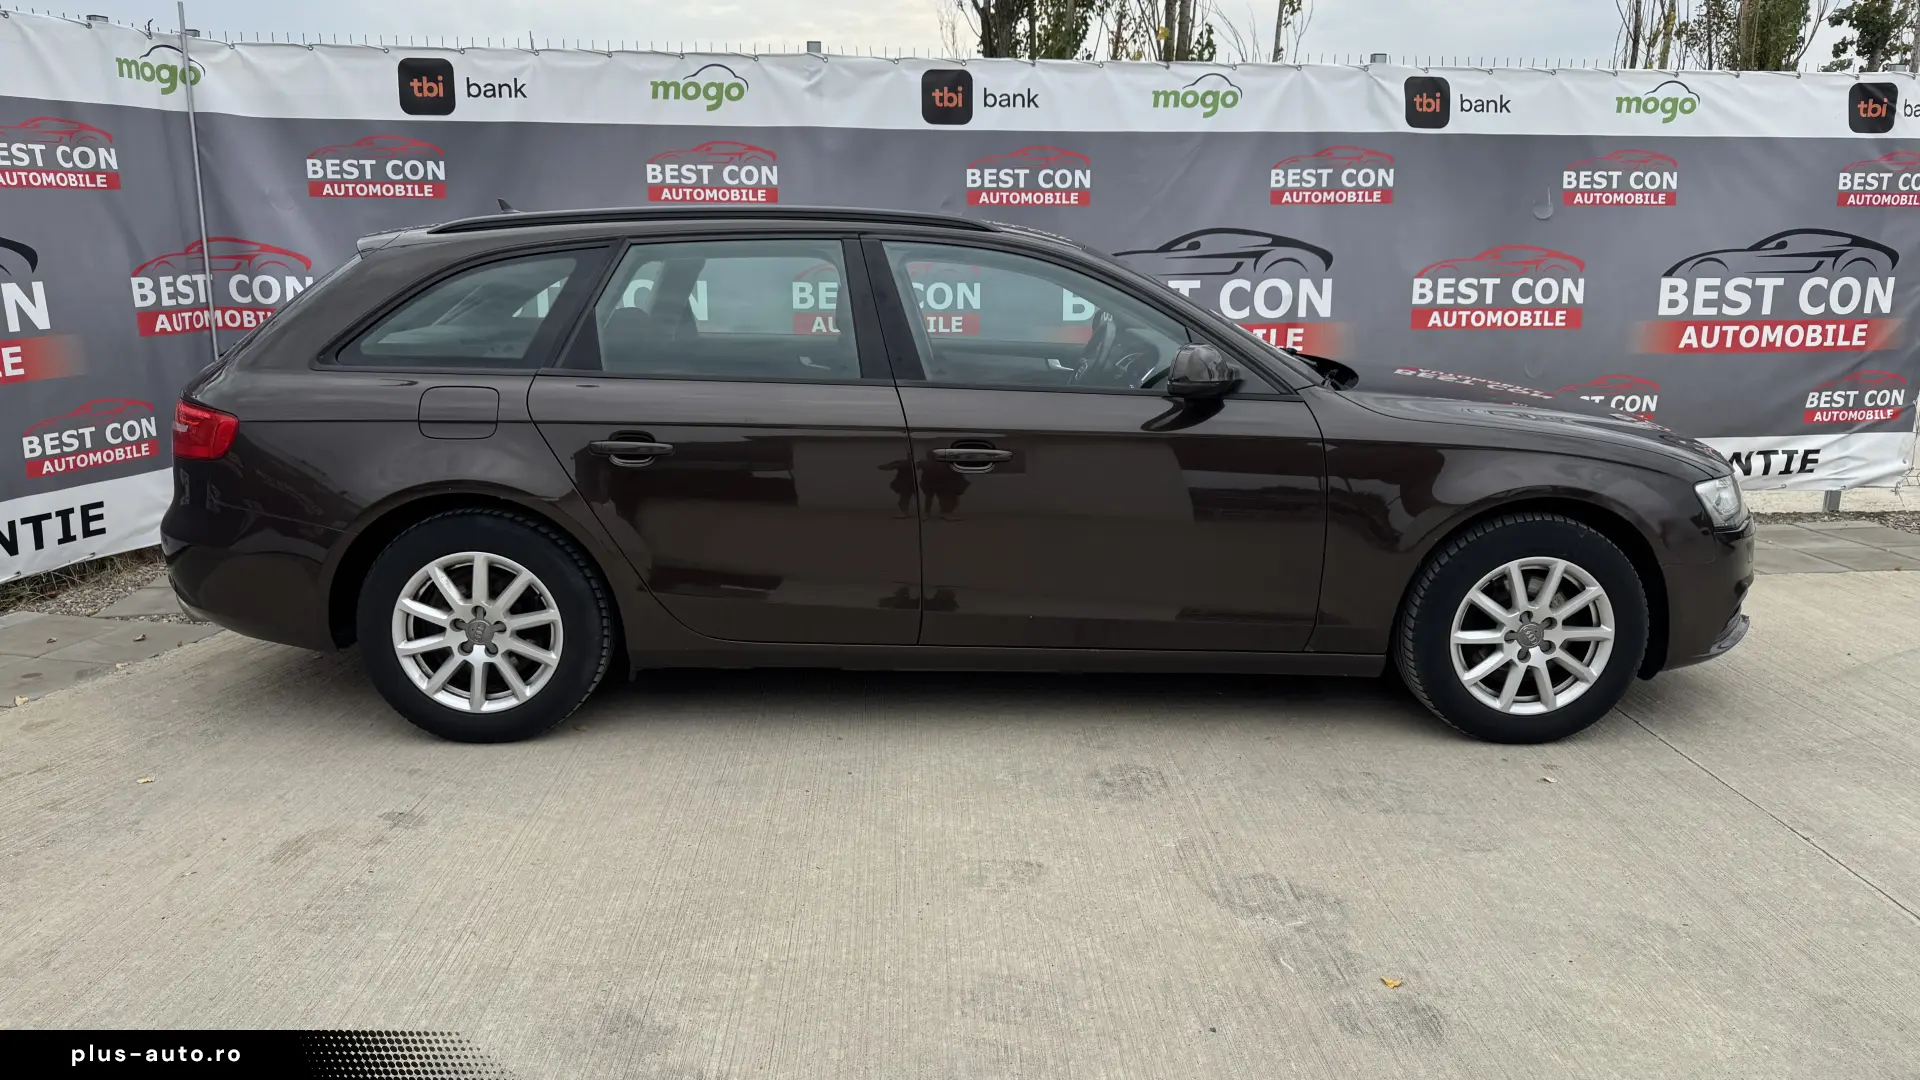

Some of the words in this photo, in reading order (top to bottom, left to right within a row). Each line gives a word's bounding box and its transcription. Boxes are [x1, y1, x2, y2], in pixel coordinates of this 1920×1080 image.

[116, 57, 201, 95] mogo
[409, 76, 444, 98] tbi
[466, 76, 527, 99] bank
[650, 80, 745, 112] mogo
[932, 86, 963, 108] tbi
[983, 87, 1039, 109] bank
[1152, 89, 1239, 118] mogo
[1413, 91, 1441, 113] tbi
[1459, 93, 1511, 114] bank
[1615, 95, 1697, 123] mogo
[1857, 97, 1888, 118] tbi
[56, 145, 119, 170] CON
[306, 159, 376, 179] BEST
[385, 159, 446, 180] CON
[646, 164, 713, 185] BEST
[722, 164, 778, 186] CON
[966, 168, 1030, 188] BEST
[1037, 168, 1091, 189] CON
[1270, 168, 1333, 188] BEST
[1341, 168, 1395, 188] CON
[1561, 171, 1622, 190] BEST
[1628, 171, 1678, 190] CON
[322, 183, 433, 197] AUTOMOBILE
[1838, 172, 1893, 191] BEST
[660, 187, 766, 202] AUTOMOBILE
[978, 191, 1079, 205] AUTOMOBILE
[1281, 191, 1382, 203] AUTOMOBILE
[1573, 192, 1666, 205] AUTOMOBILE
[130, 273, 213, 308] BEST
[228, 274, 313, 305] CON
[1219, 278, 1333, 319] CON
[1411, 277, 1501, 305] BEST
[1511, 277, 1585, 305] CON
[1657, 276, 1785, 316] BEST
[1798, 276, 1896, 315] CON
[154, 310, 273, 333] AUTOMOBI
[1427, 309, 1567, 327] AUTOMOBILE
[1678, 323, 1868, 349] AUTOMOBILE
[1610, 394, 1658, 413] CON
[1805, 390, 1859, 409] BEST
[1864, 388, 1905, 408] CON
[1813, 408, 1894, 422] AUTOMOBILE
[22, 426, 96, 459] BEST
[105, 416, 157, 445] CON
[42, 442, 151, 475] AUTOMOBILE
